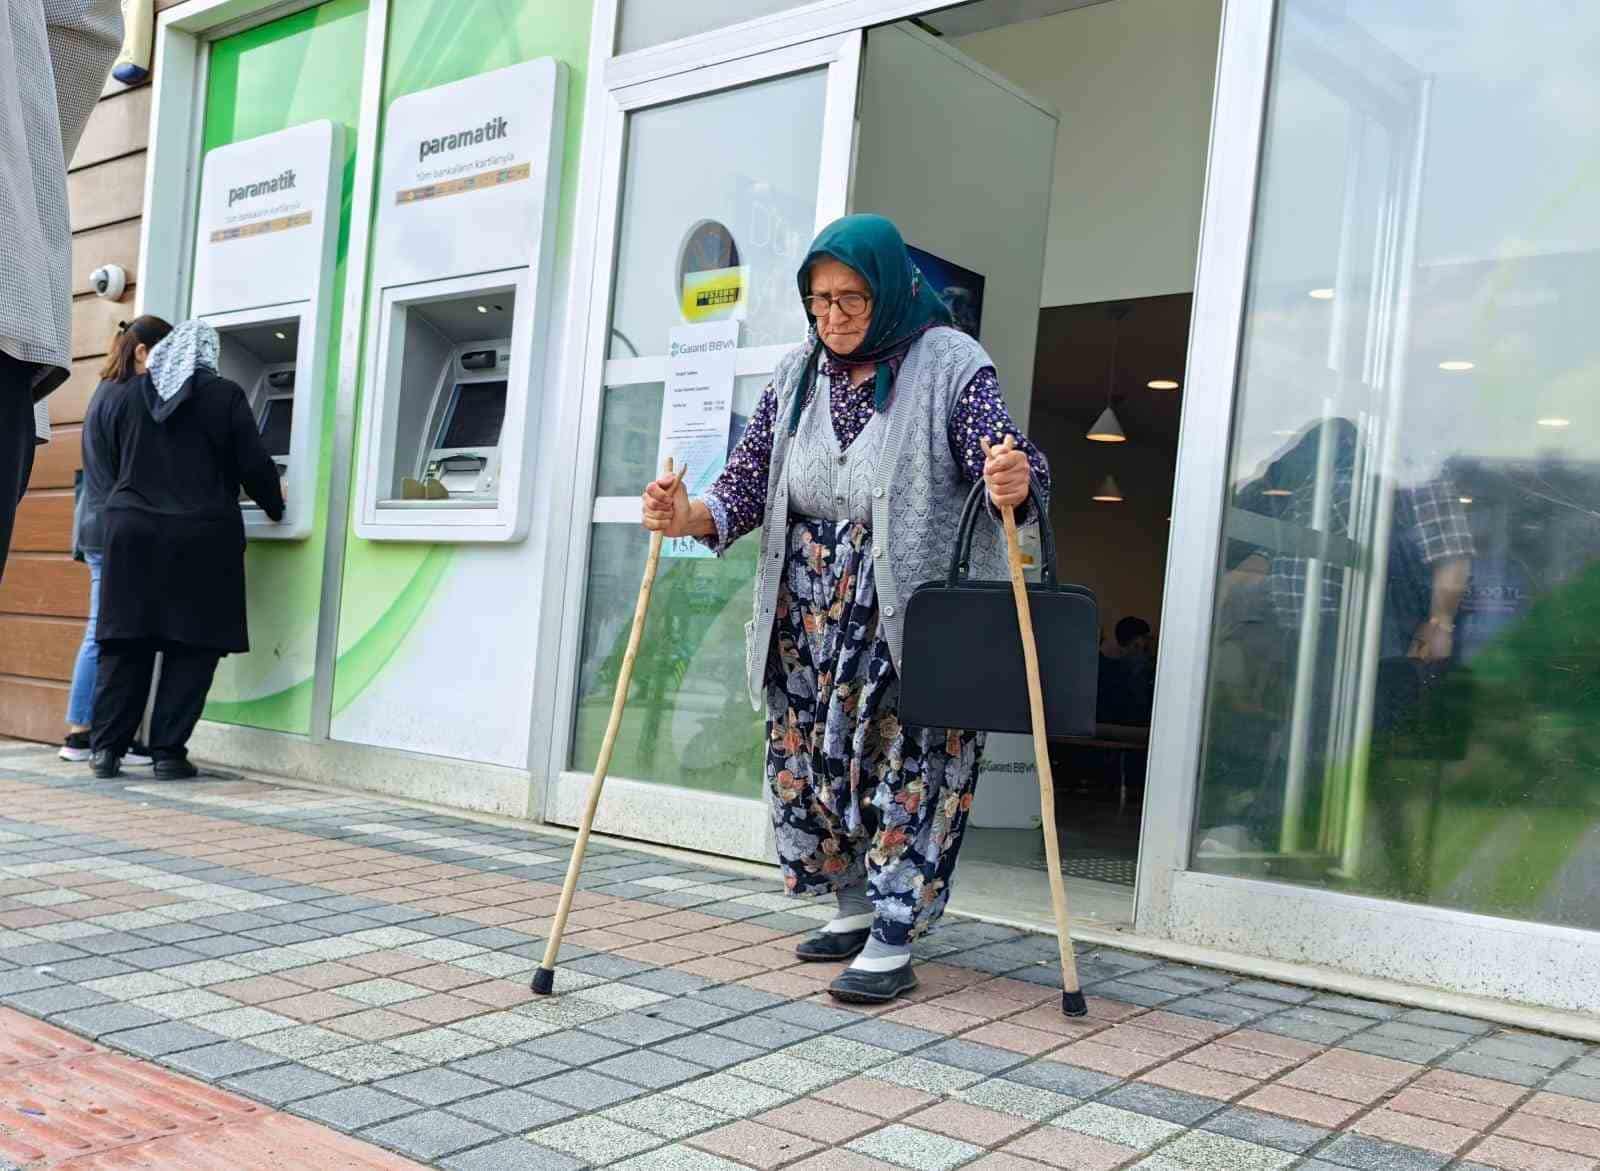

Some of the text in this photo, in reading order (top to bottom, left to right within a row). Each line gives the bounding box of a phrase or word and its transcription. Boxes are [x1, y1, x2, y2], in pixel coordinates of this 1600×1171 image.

[419, 116, 508, 162] paramatik
[228, 169, 297, 208] paramatik
[679, 342, 708, 355] Garanti
